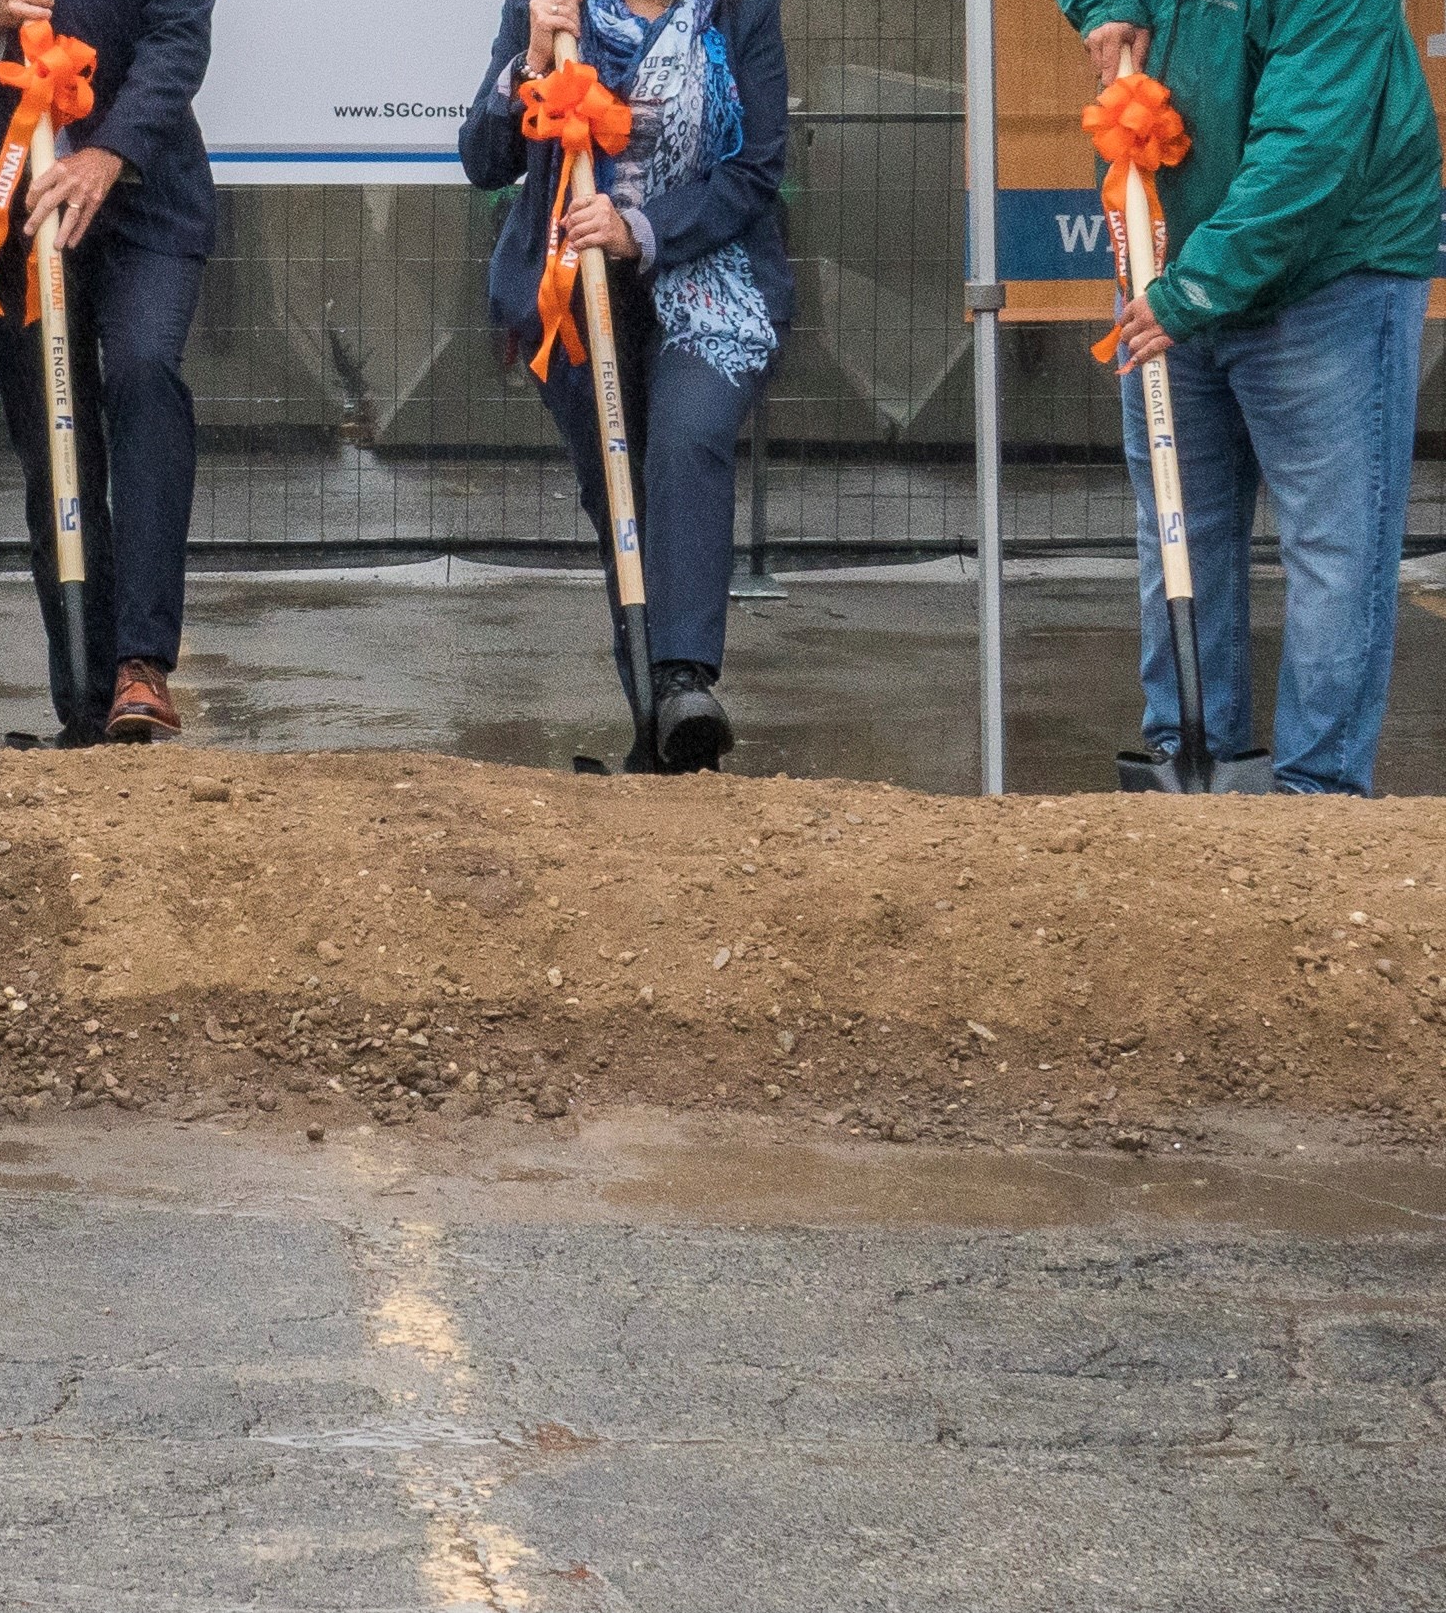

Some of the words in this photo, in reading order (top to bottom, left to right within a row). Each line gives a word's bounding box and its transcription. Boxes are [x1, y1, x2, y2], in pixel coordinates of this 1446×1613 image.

[1056, 215, 1110, 253] W
[48, 254, 65, 312] LiUNA!
[52, 335, 68, 406] FENGATE
[601, 361, 620, 428] FENGATE
[1146, 360, 1165, 425] FENGATE
